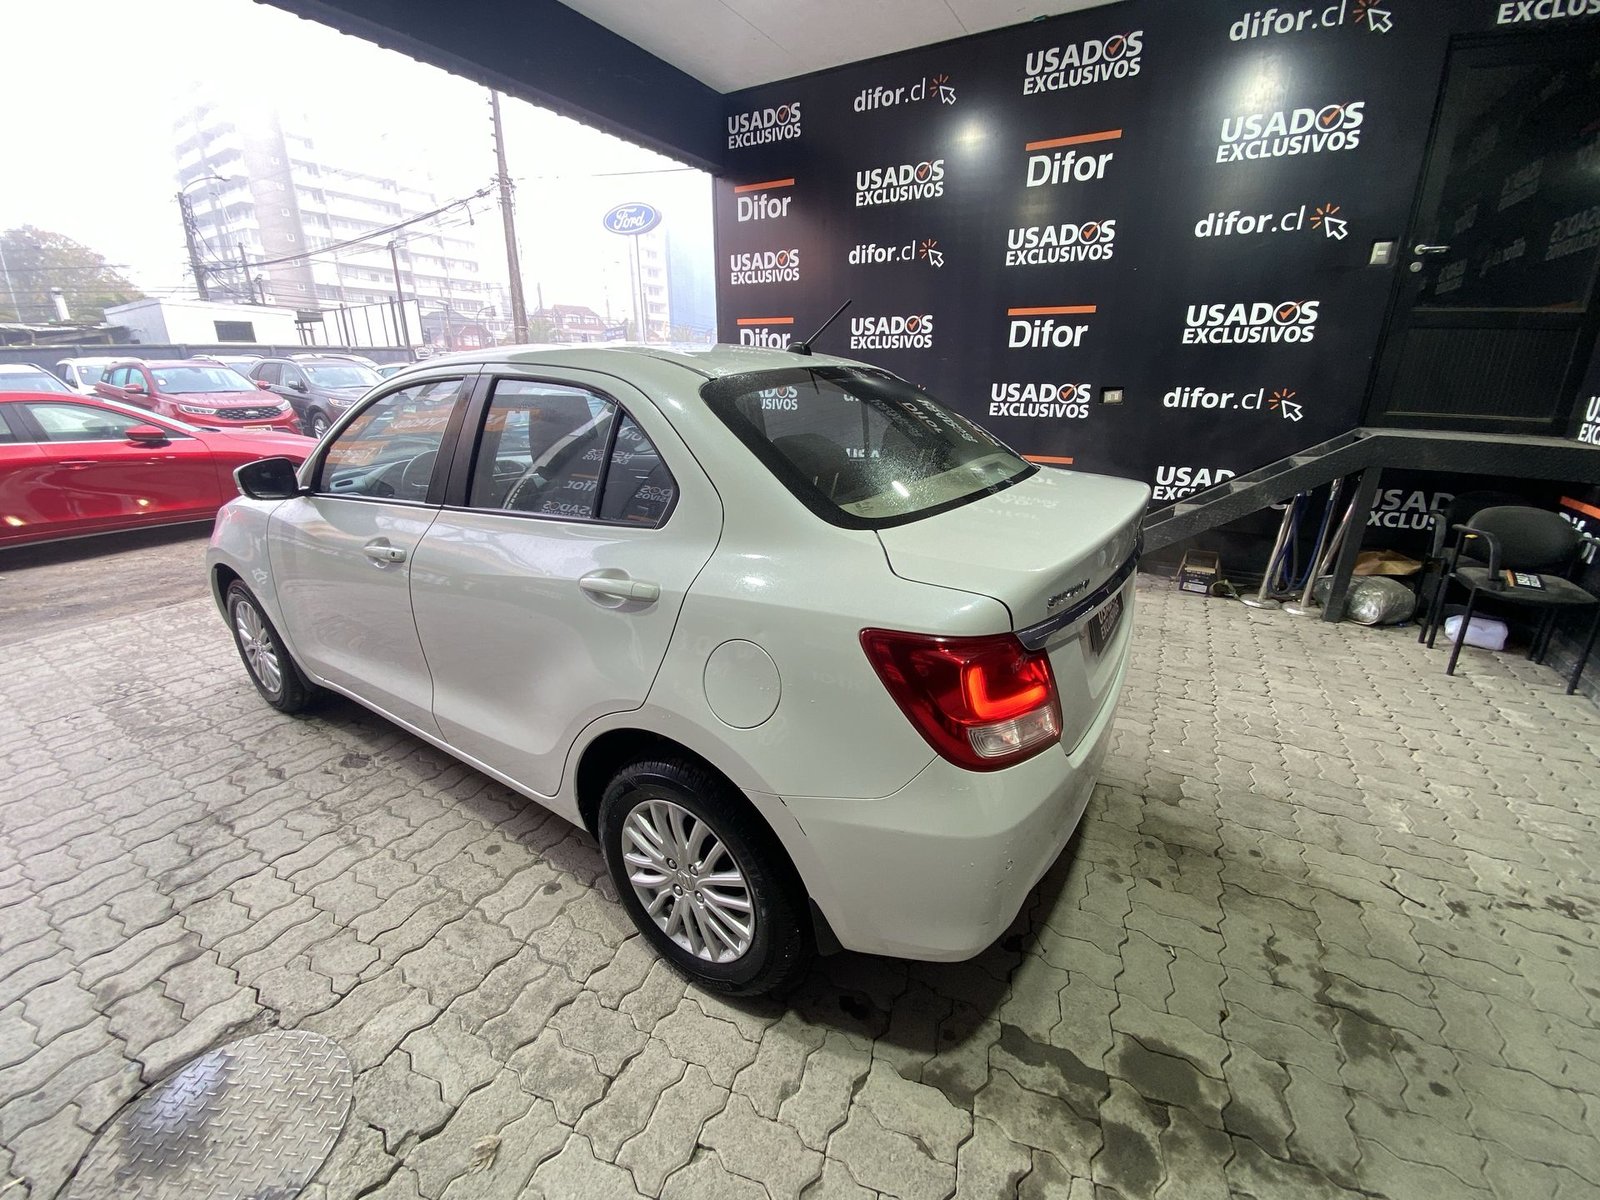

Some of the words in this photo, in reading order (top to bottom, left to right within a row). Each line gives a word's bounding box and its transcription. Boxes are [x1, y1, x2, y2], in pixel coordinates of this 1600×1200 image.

[1229, 0, 1346, 41] difor.cl
[1026, 30, 1143, 76] USADOS
[1023, 57, 1141, 95] EXCLUSIVOS
[853, 78, 926, 112] difor.cl
[728, 102, 801, 134] USADOS
[1220, 102, 1365, 143] USADOS
[728, 122, 801, 149] EXCLUSIVOS
[1215, 130, 1361, 163] EXCLUSIVOS
[856, 160, 944, 191] USADOS
[1026, 151, 1113, 187] Difor
[855, 182, 944, 206] EXCLUSIVOS
[614, 208, 646, 230] Ford
[737, 194, 791, 222] Difor
[1194, 205, 1306, 238] difor.cl
[1008, 220, 1116, 250] USADOS
[730, 249, 799, 271] USADOS
[848, 240, 916, 265] difor.cl
[1005, 243, 1113, 266] EXCLUSIVOS
[730, 267, 799, 285] EXCLUSIVOS
[850, 314, 933, 335] USADOS
[1186, 300, 1319, 327] USADOS
[739, 328, 791, 349] Difor
[850, 331, 933, 349] EXCLUSIVOS
[1007, 320, 1089, 348] Difor
[1182, 325, 1315, 344] EXCLUSIVOS
[991, 383, 1092, 403] USADOS
[1163, 387, 1265, 410] difor.cl
[988, 402, 1091, 419] EXCLUSIVOS
